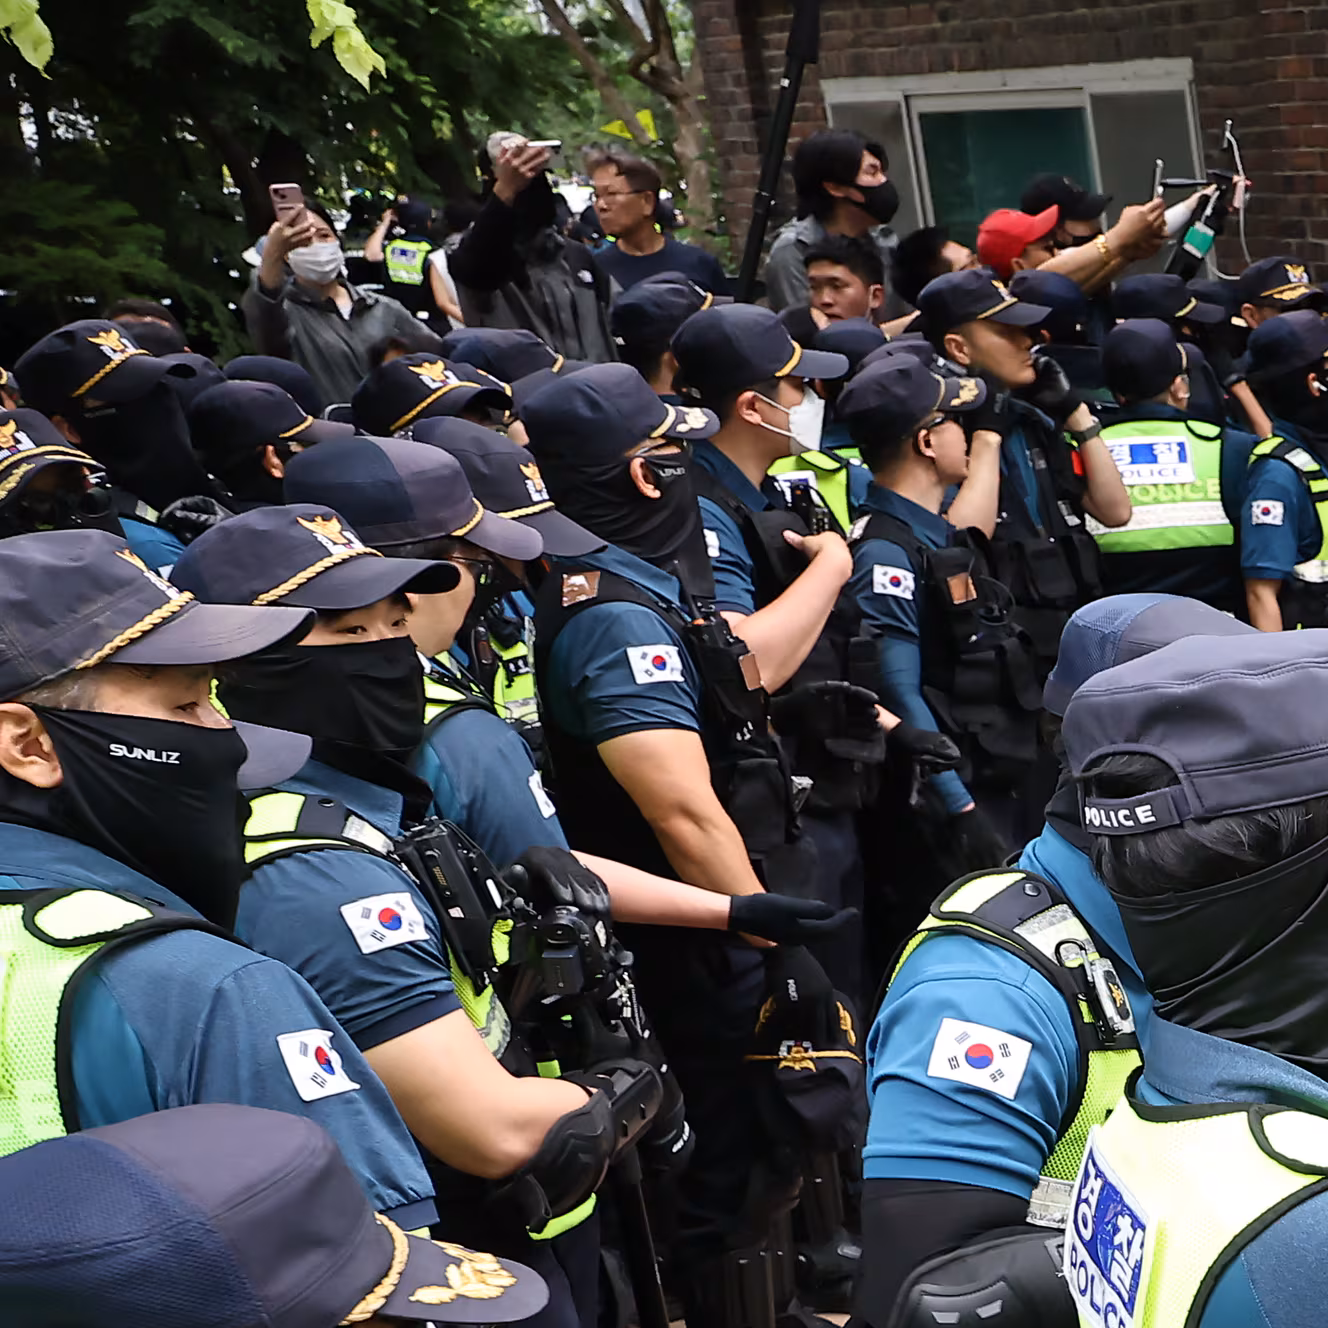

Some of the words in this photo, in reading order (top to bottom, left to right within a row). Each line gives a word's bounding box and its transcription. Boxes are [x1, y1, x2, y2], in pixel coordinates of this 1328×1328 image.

[1121, 467, 1181, 479] OLICE
[109, 743, 181, 764] SUNLIZ
[1084, 804, 1156, 829] POLICE
[1081, 1158, 1145, 1301] 경찰
